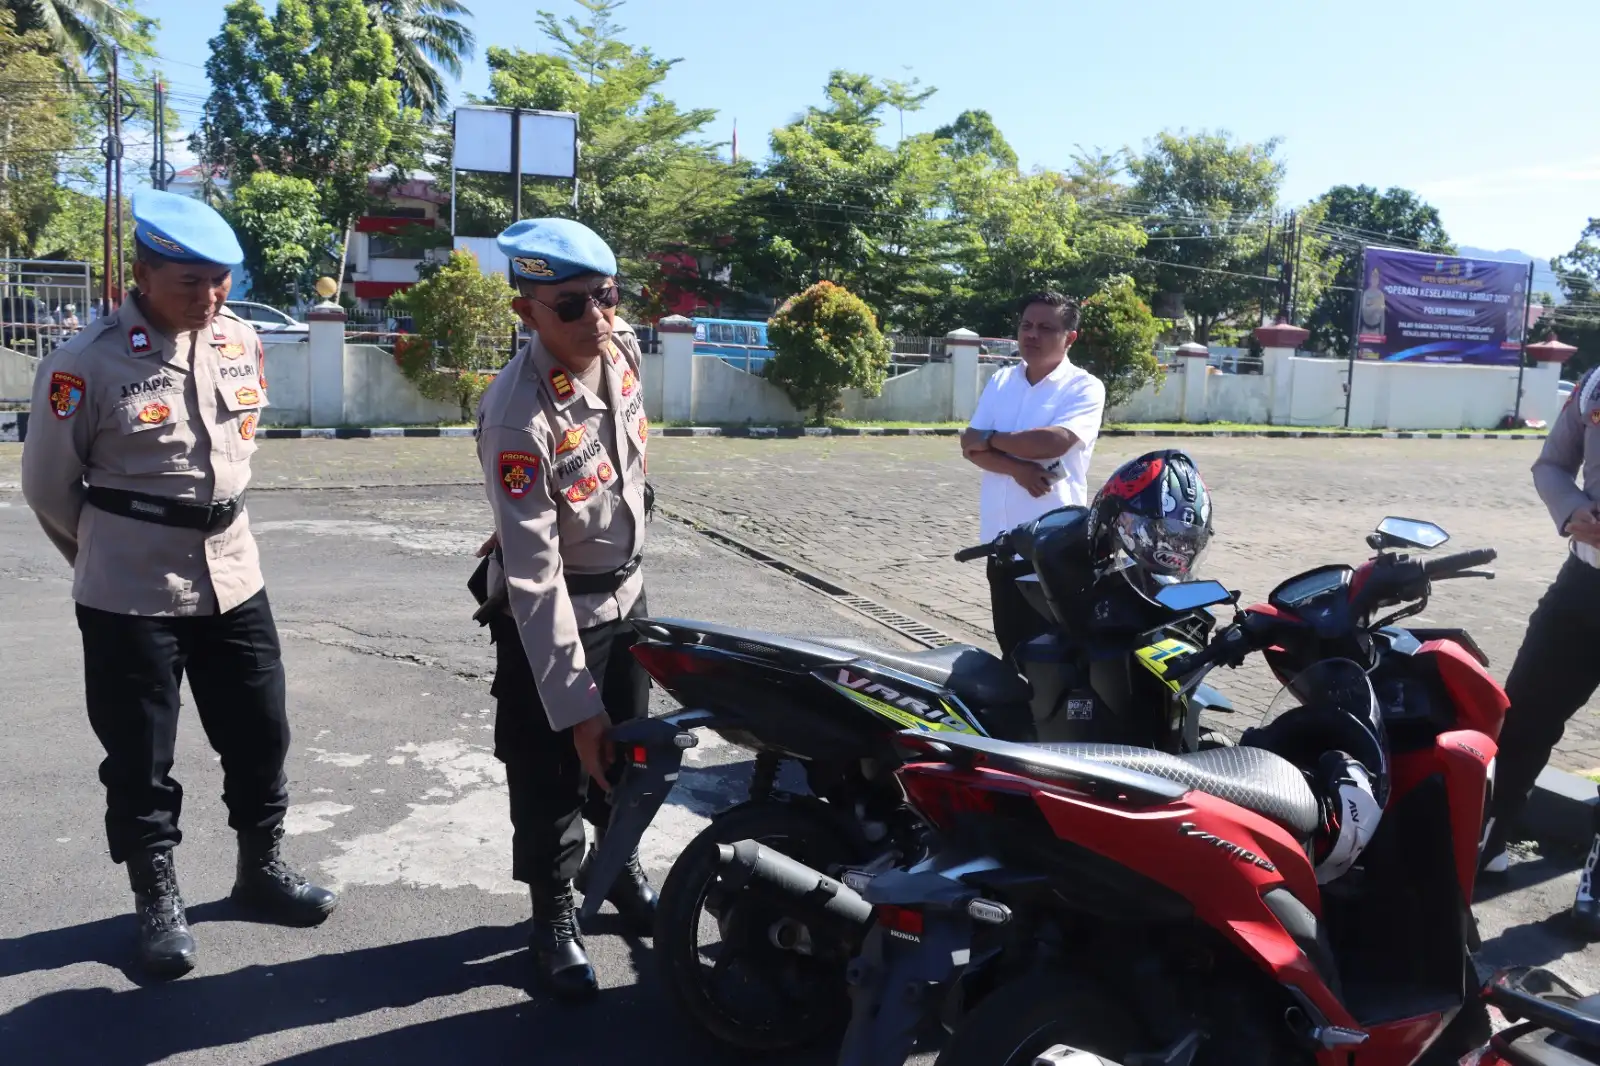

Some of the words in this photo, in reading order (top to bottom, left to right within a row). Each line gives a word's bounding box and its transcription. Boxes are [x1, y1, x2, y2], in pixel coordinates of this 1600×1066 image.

[54, 372, 83, 386] PROPAM
[220, 364, 255, 379] POLRI
[121, 376, 173, 398] J.DAPA
[502, 453, 536, 463] PROPAM
[558, 439, 602, 480] FIRDAUS
[837, 668, 968, 733] VARIO
[890, 929, 920, 943] HONDA
